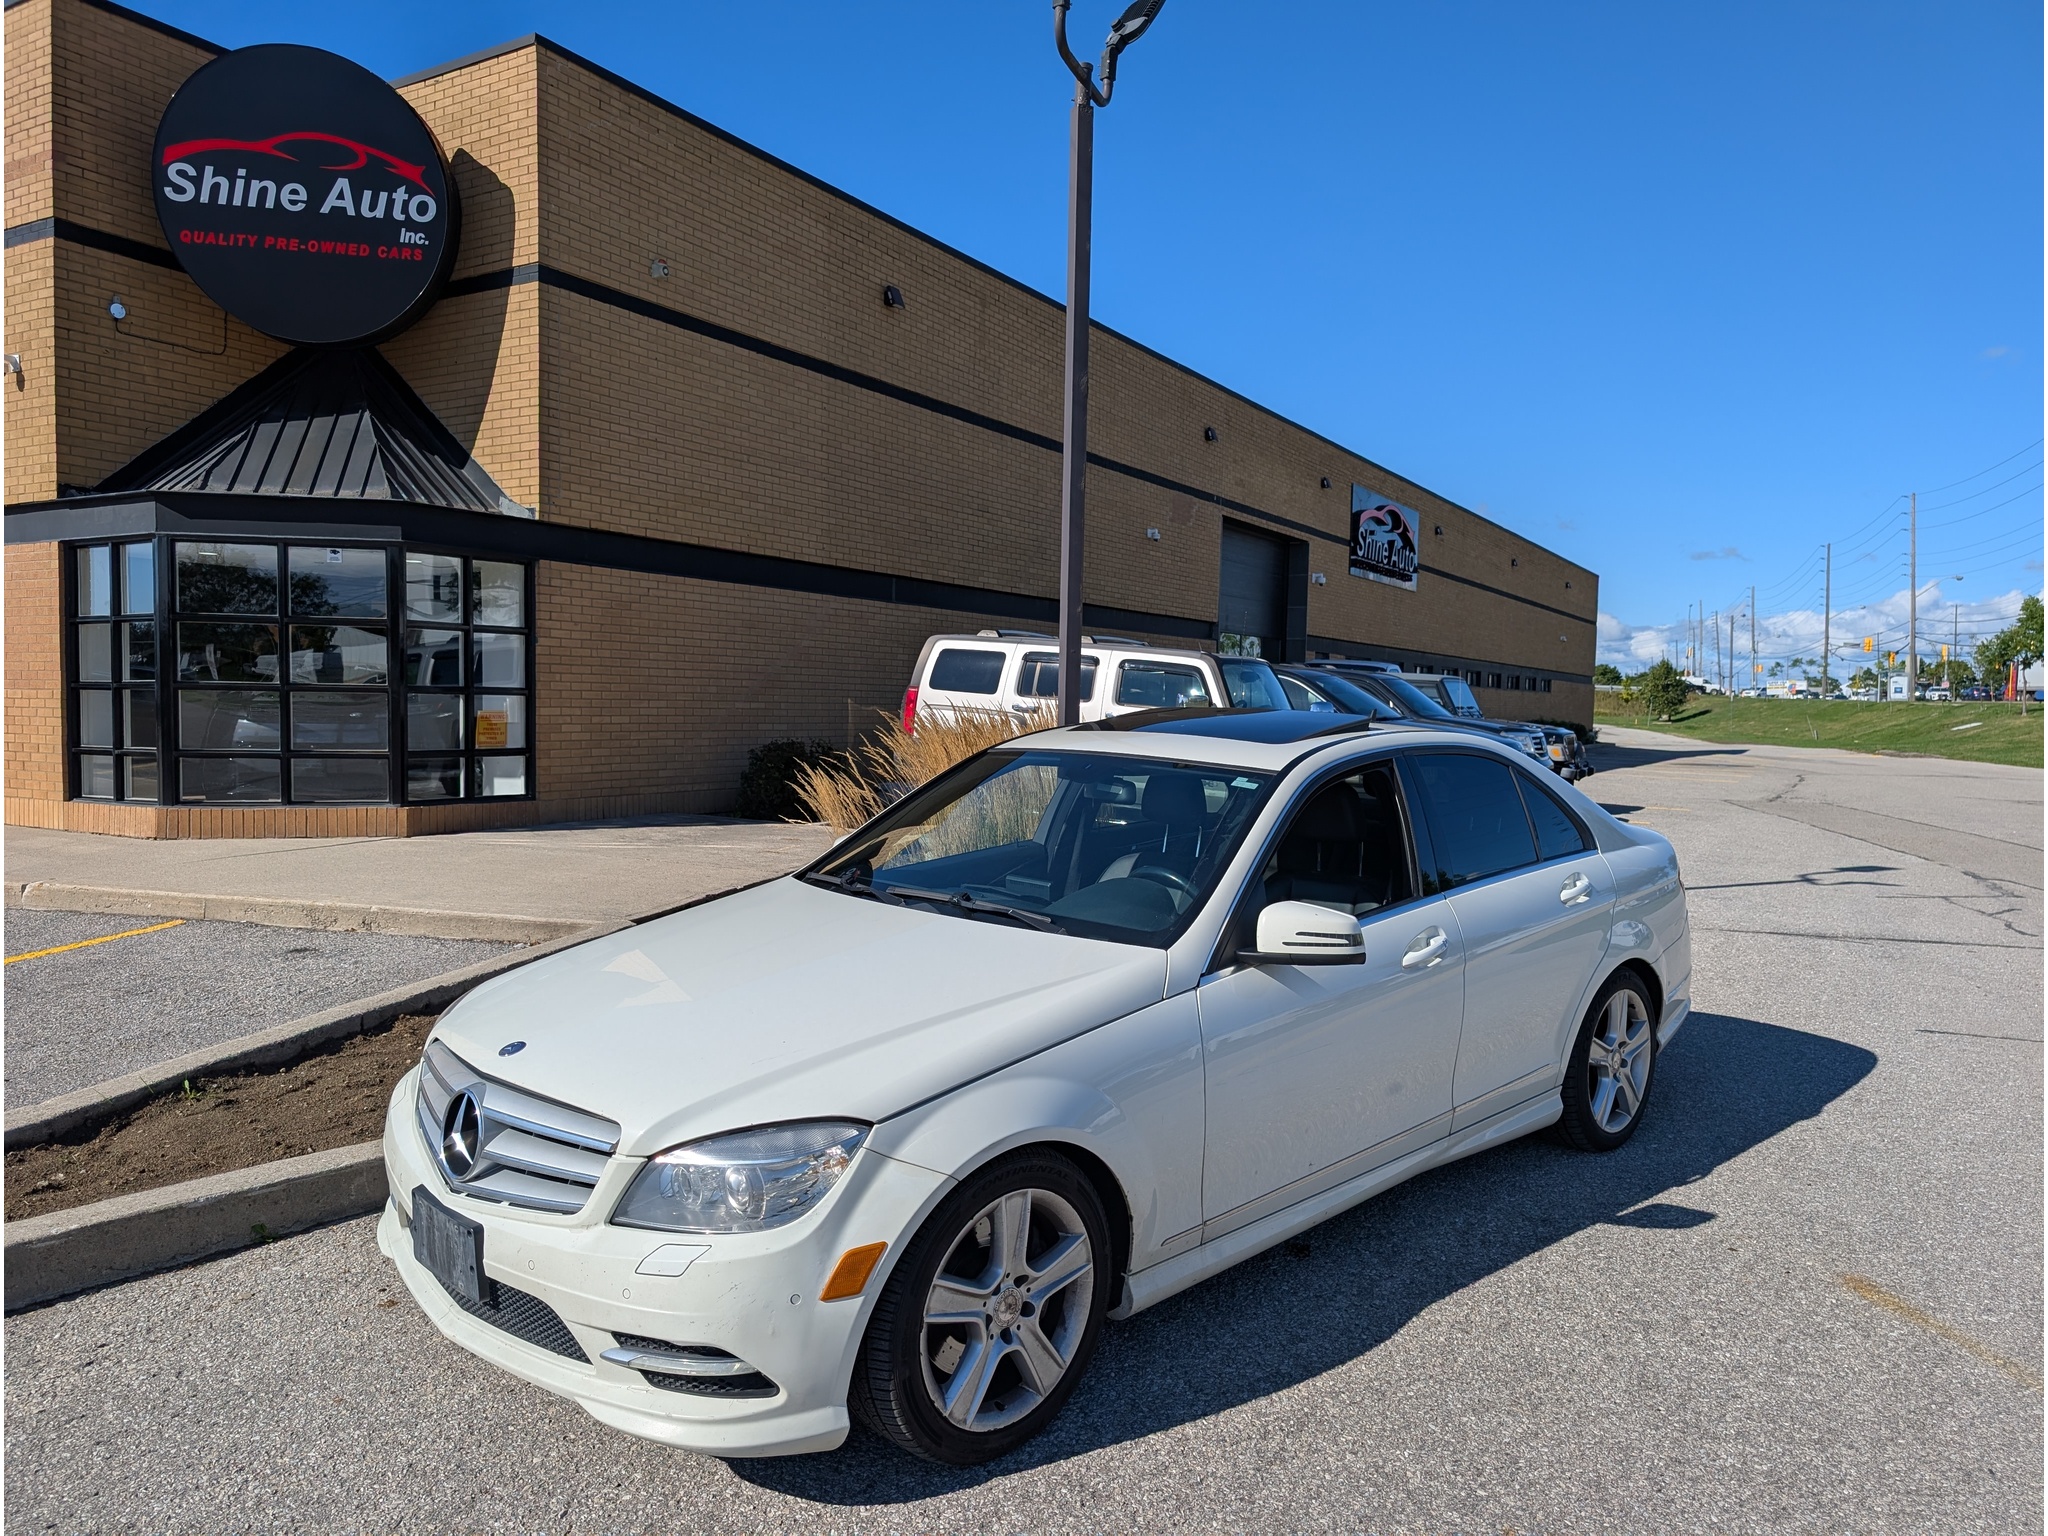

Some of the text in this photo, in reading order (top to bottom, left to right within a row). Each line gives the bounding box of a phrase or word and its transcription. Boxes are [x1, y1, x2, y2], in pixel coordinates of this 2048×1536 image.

[163, 162, 437, 223] Shine Auto
[179, 229, 424, 261] QUALITY PRE-OWNED CARS
[399, 228, 429, 246] Inc.
[1357, 527, 1389, 565] Shine
[1390, 540, 1415, 573] Auto
